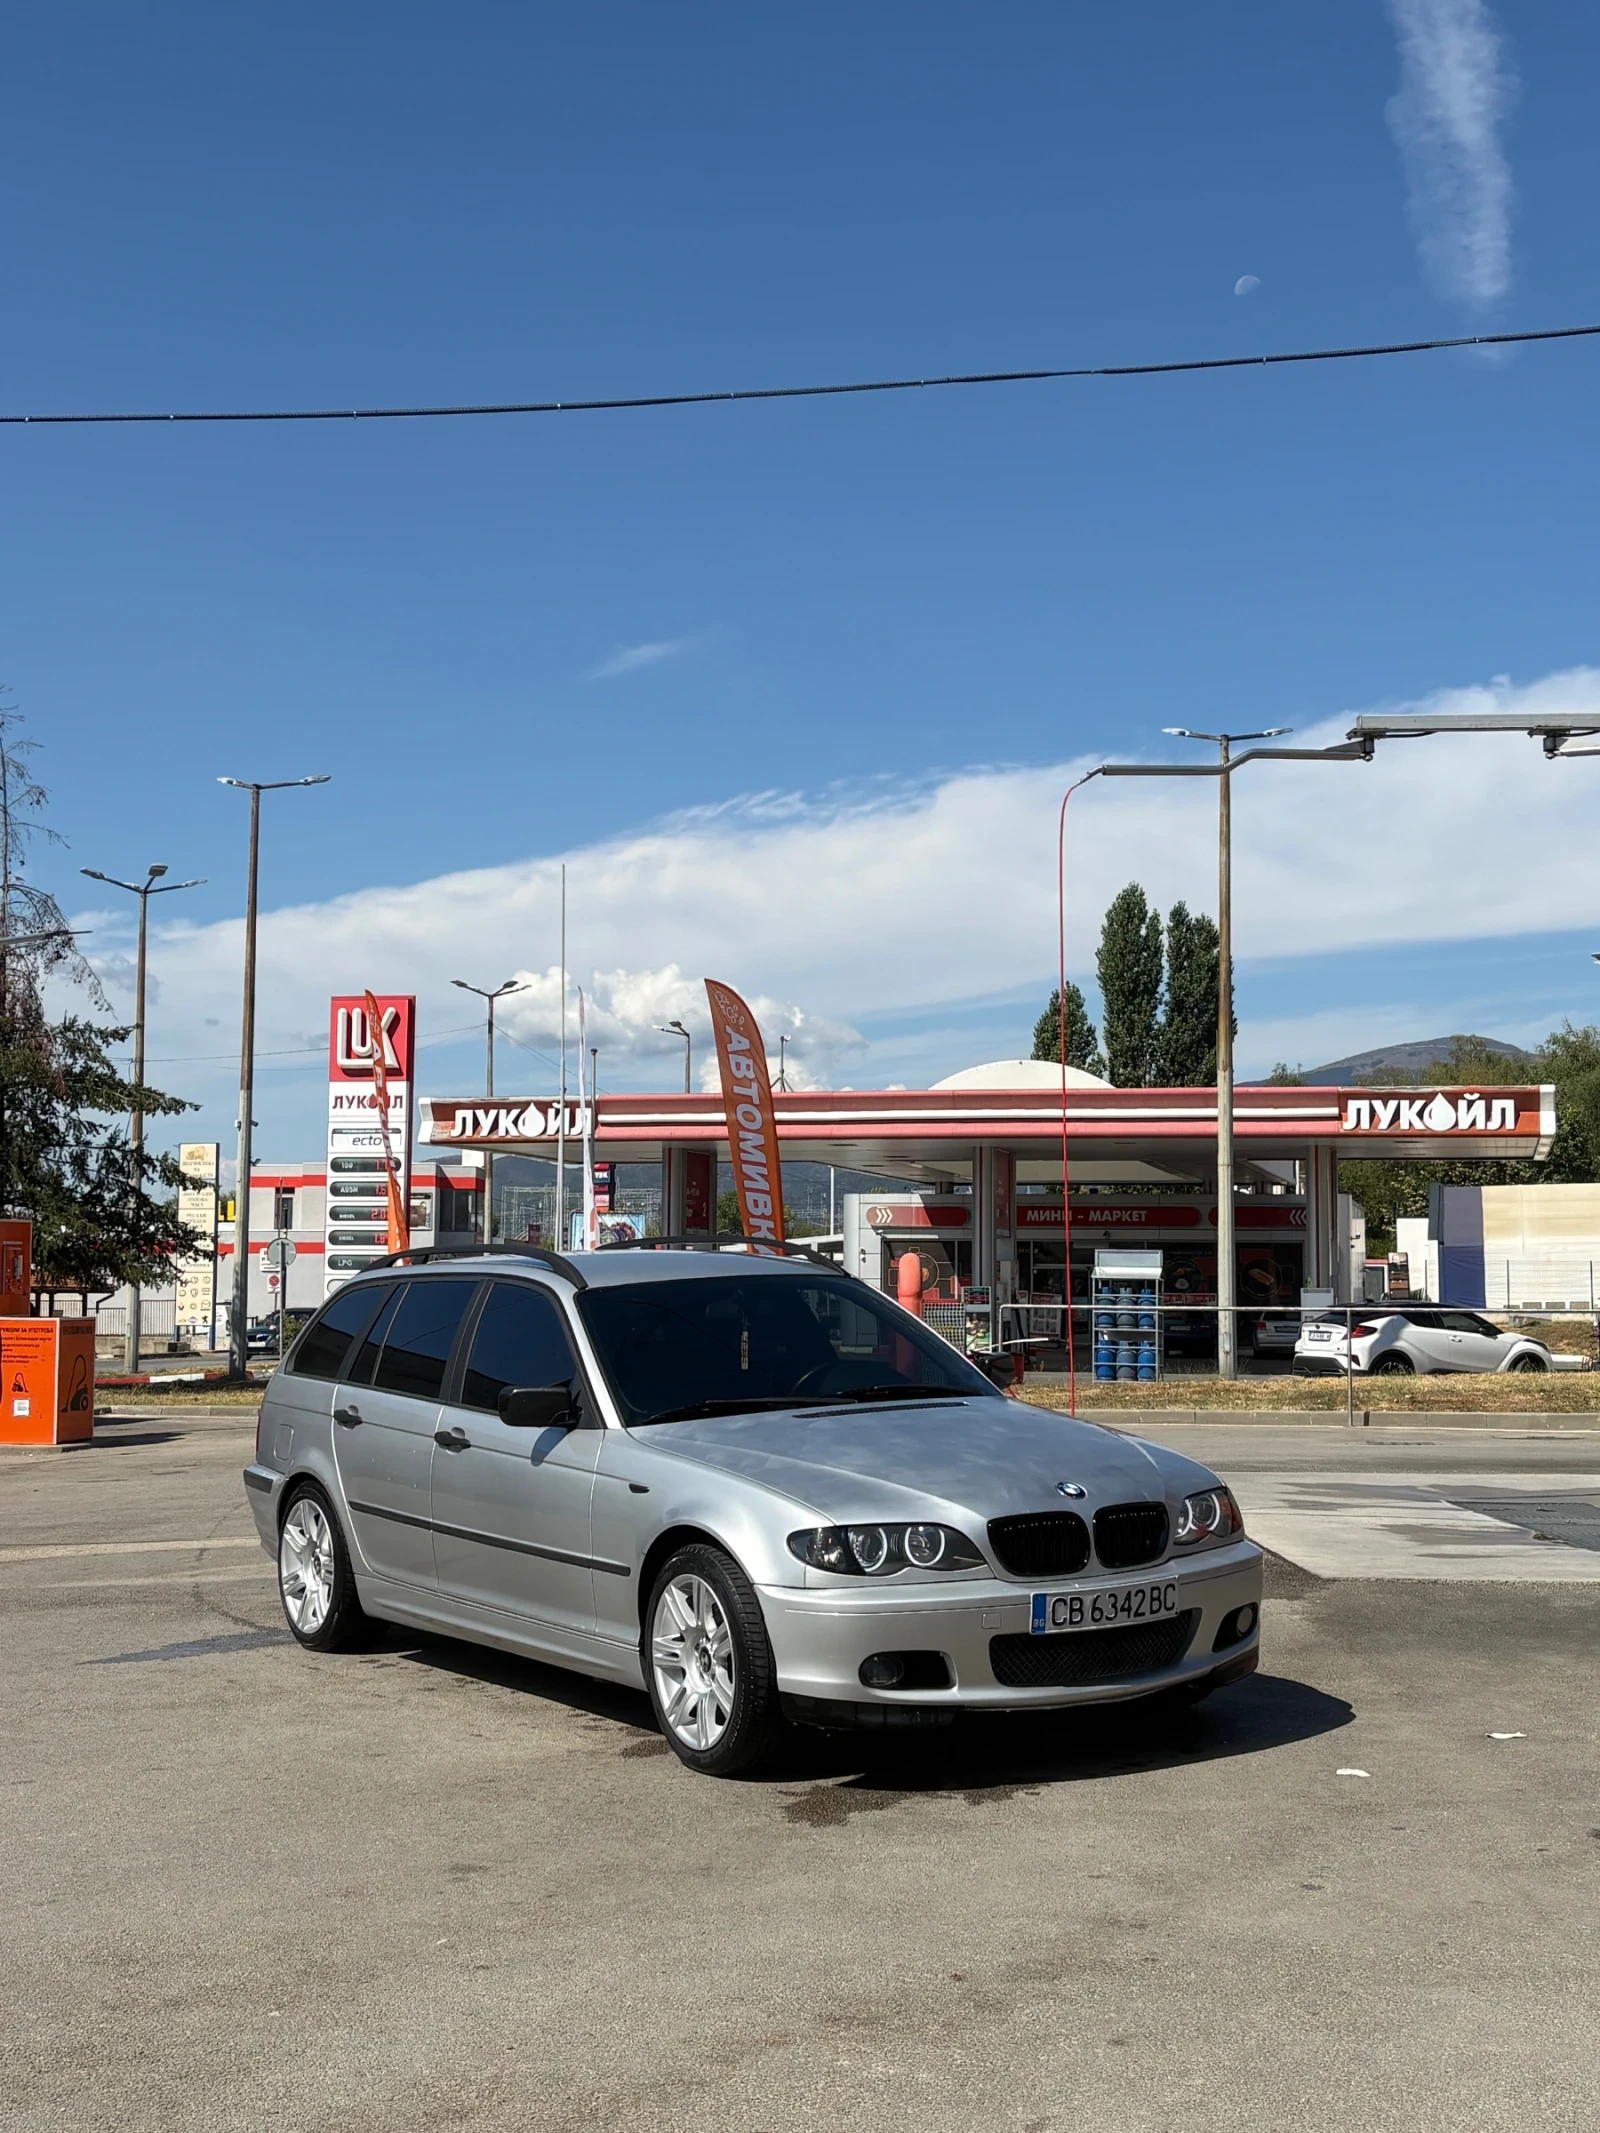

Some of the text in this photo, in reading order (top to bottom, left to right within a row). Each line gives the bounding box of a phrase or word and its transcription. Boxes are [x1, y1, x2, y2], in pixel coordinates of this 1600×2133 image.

[450, 1102, 592, 1137] ЛУКОЙЛ
[1343, 1092, 1515, 1131] ЛУКОЙЛ
[352, 1135, 382, 1146] ecto
[725, 1024, 777, 1254] АВТОМИВК
[1088, 1210, 1148, 1222] МАРКЕТ
[1051, 1583, 1176, 1626] CB 6342 BC
[1033, 1618, 1045, 1627] BG
